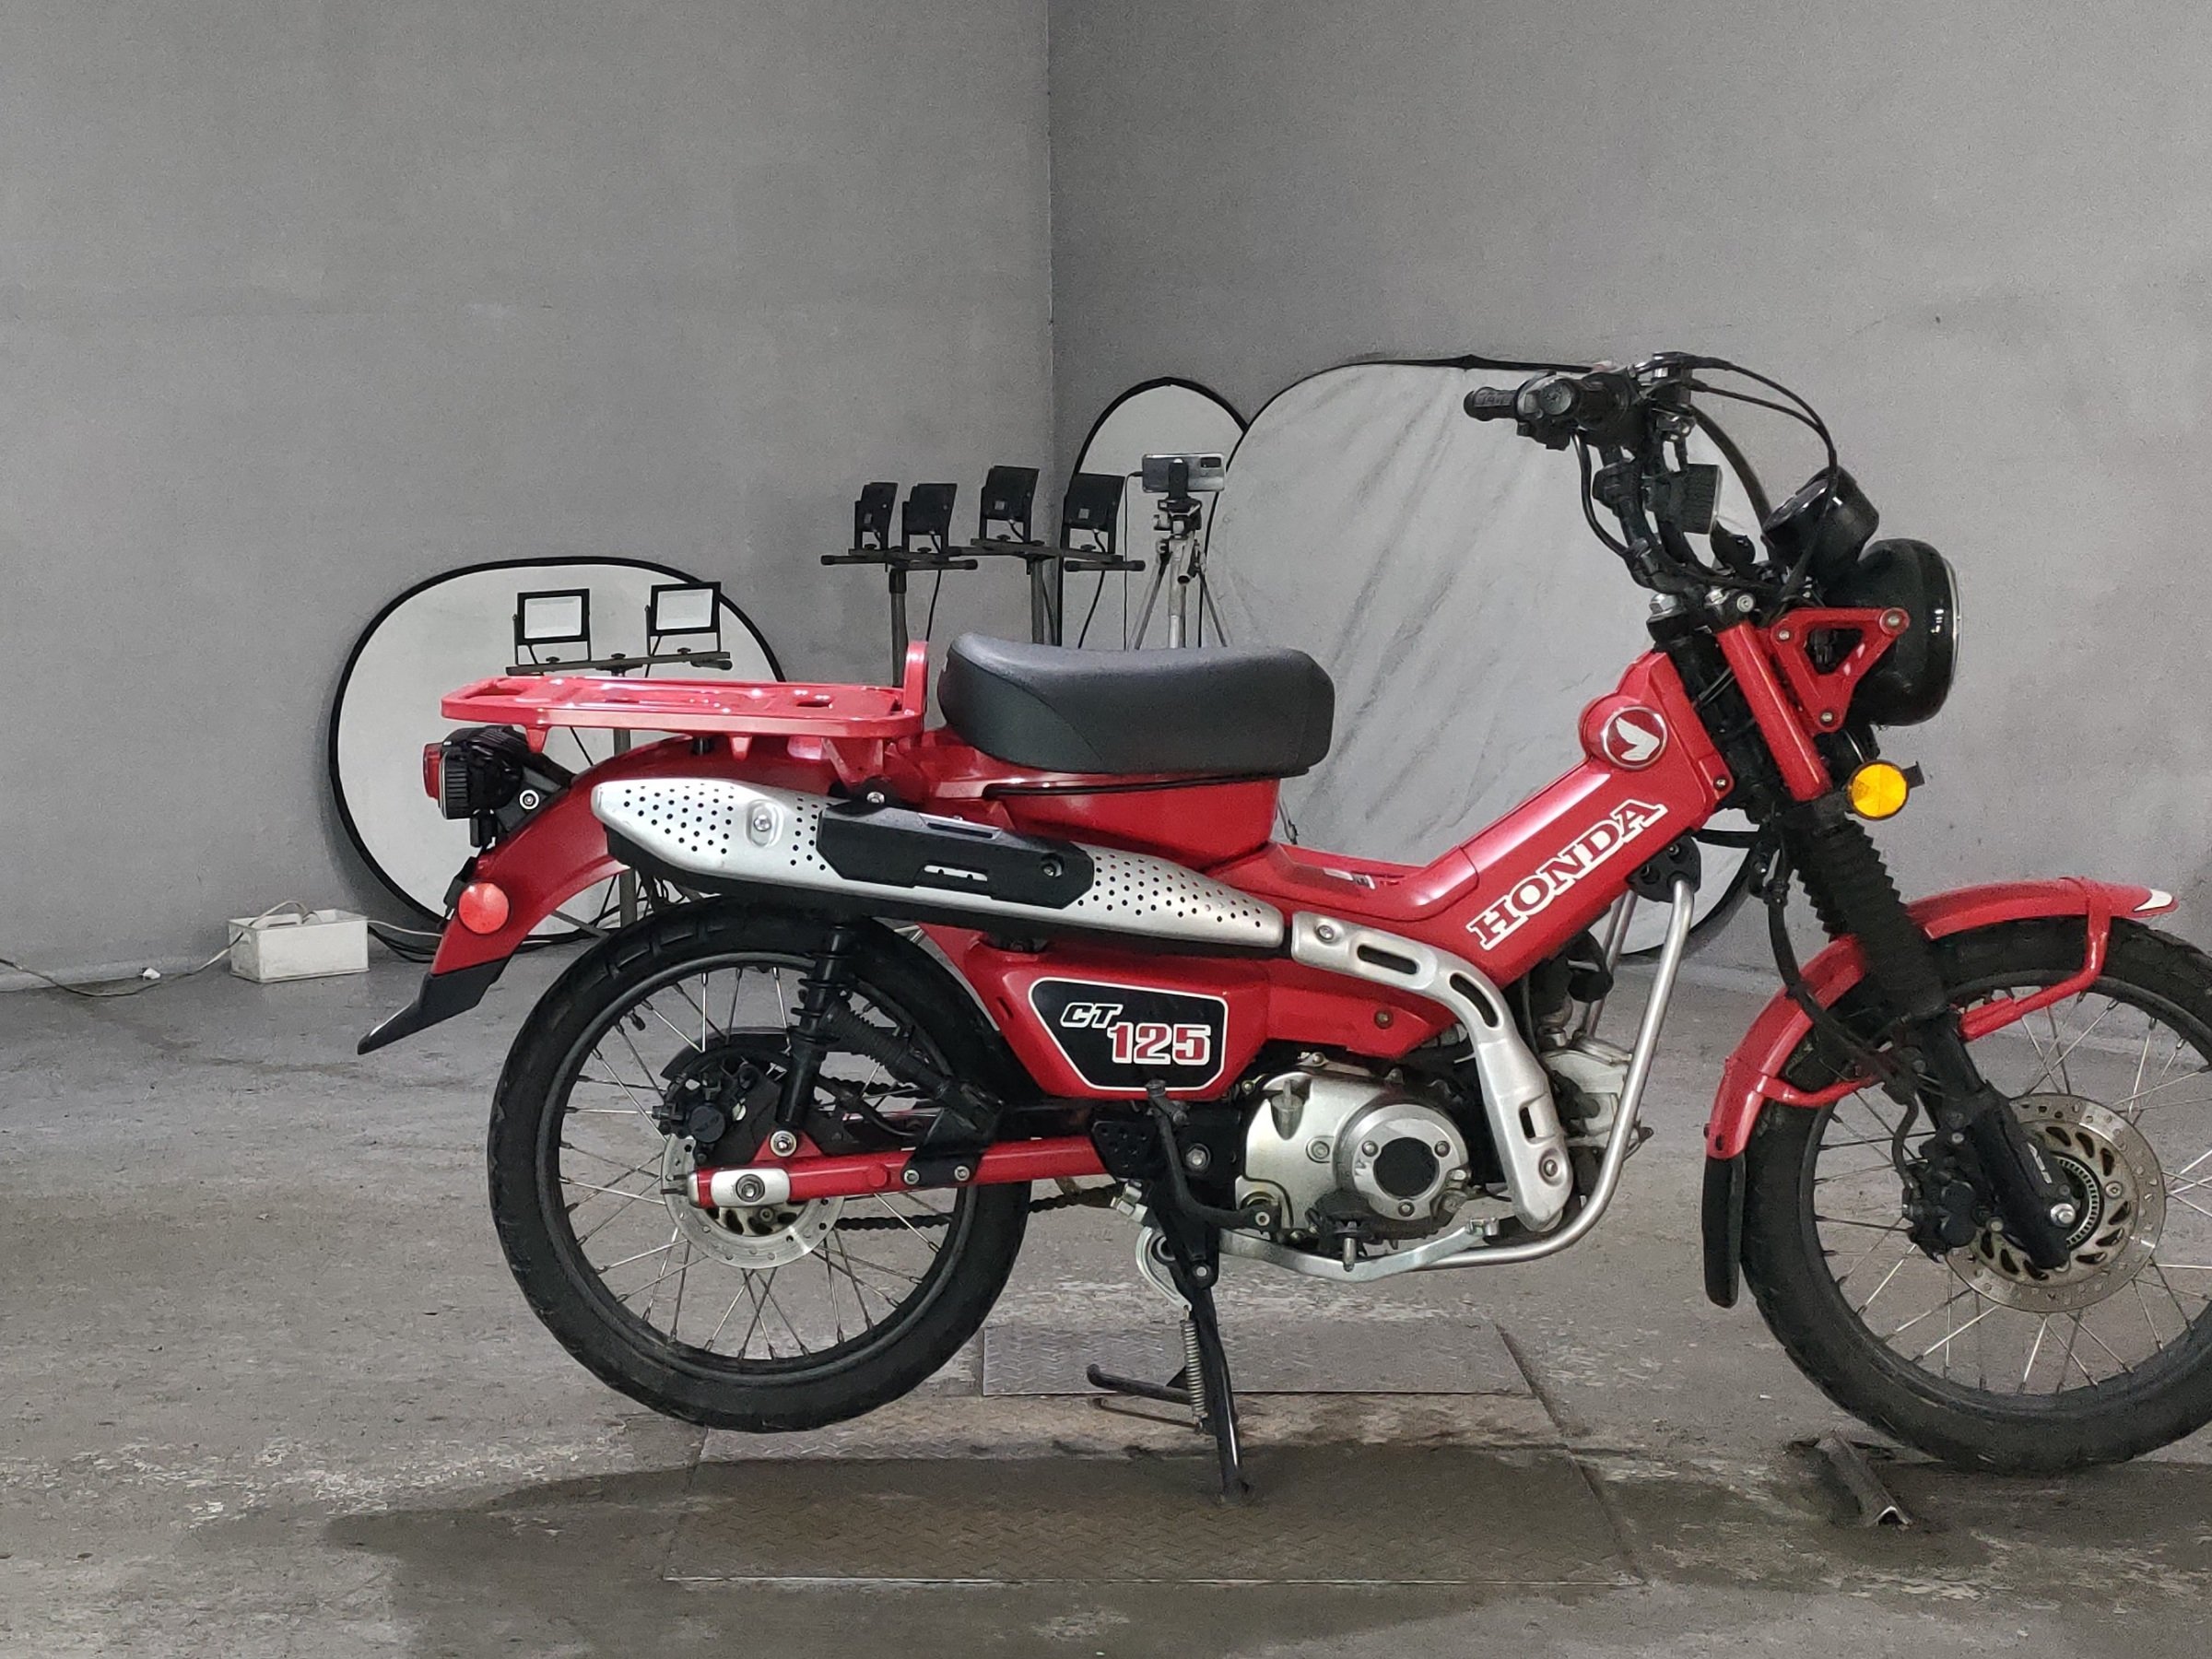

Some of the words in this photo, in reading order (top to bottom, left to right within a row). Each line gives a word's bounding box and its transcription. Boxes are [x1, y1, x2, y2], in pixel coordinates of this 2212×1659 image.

[1465, 799, 1668, 950] HONDA
[1060, 1003, 1124, 1029] CT
[1107, 1022, 1212, 1066] 125
